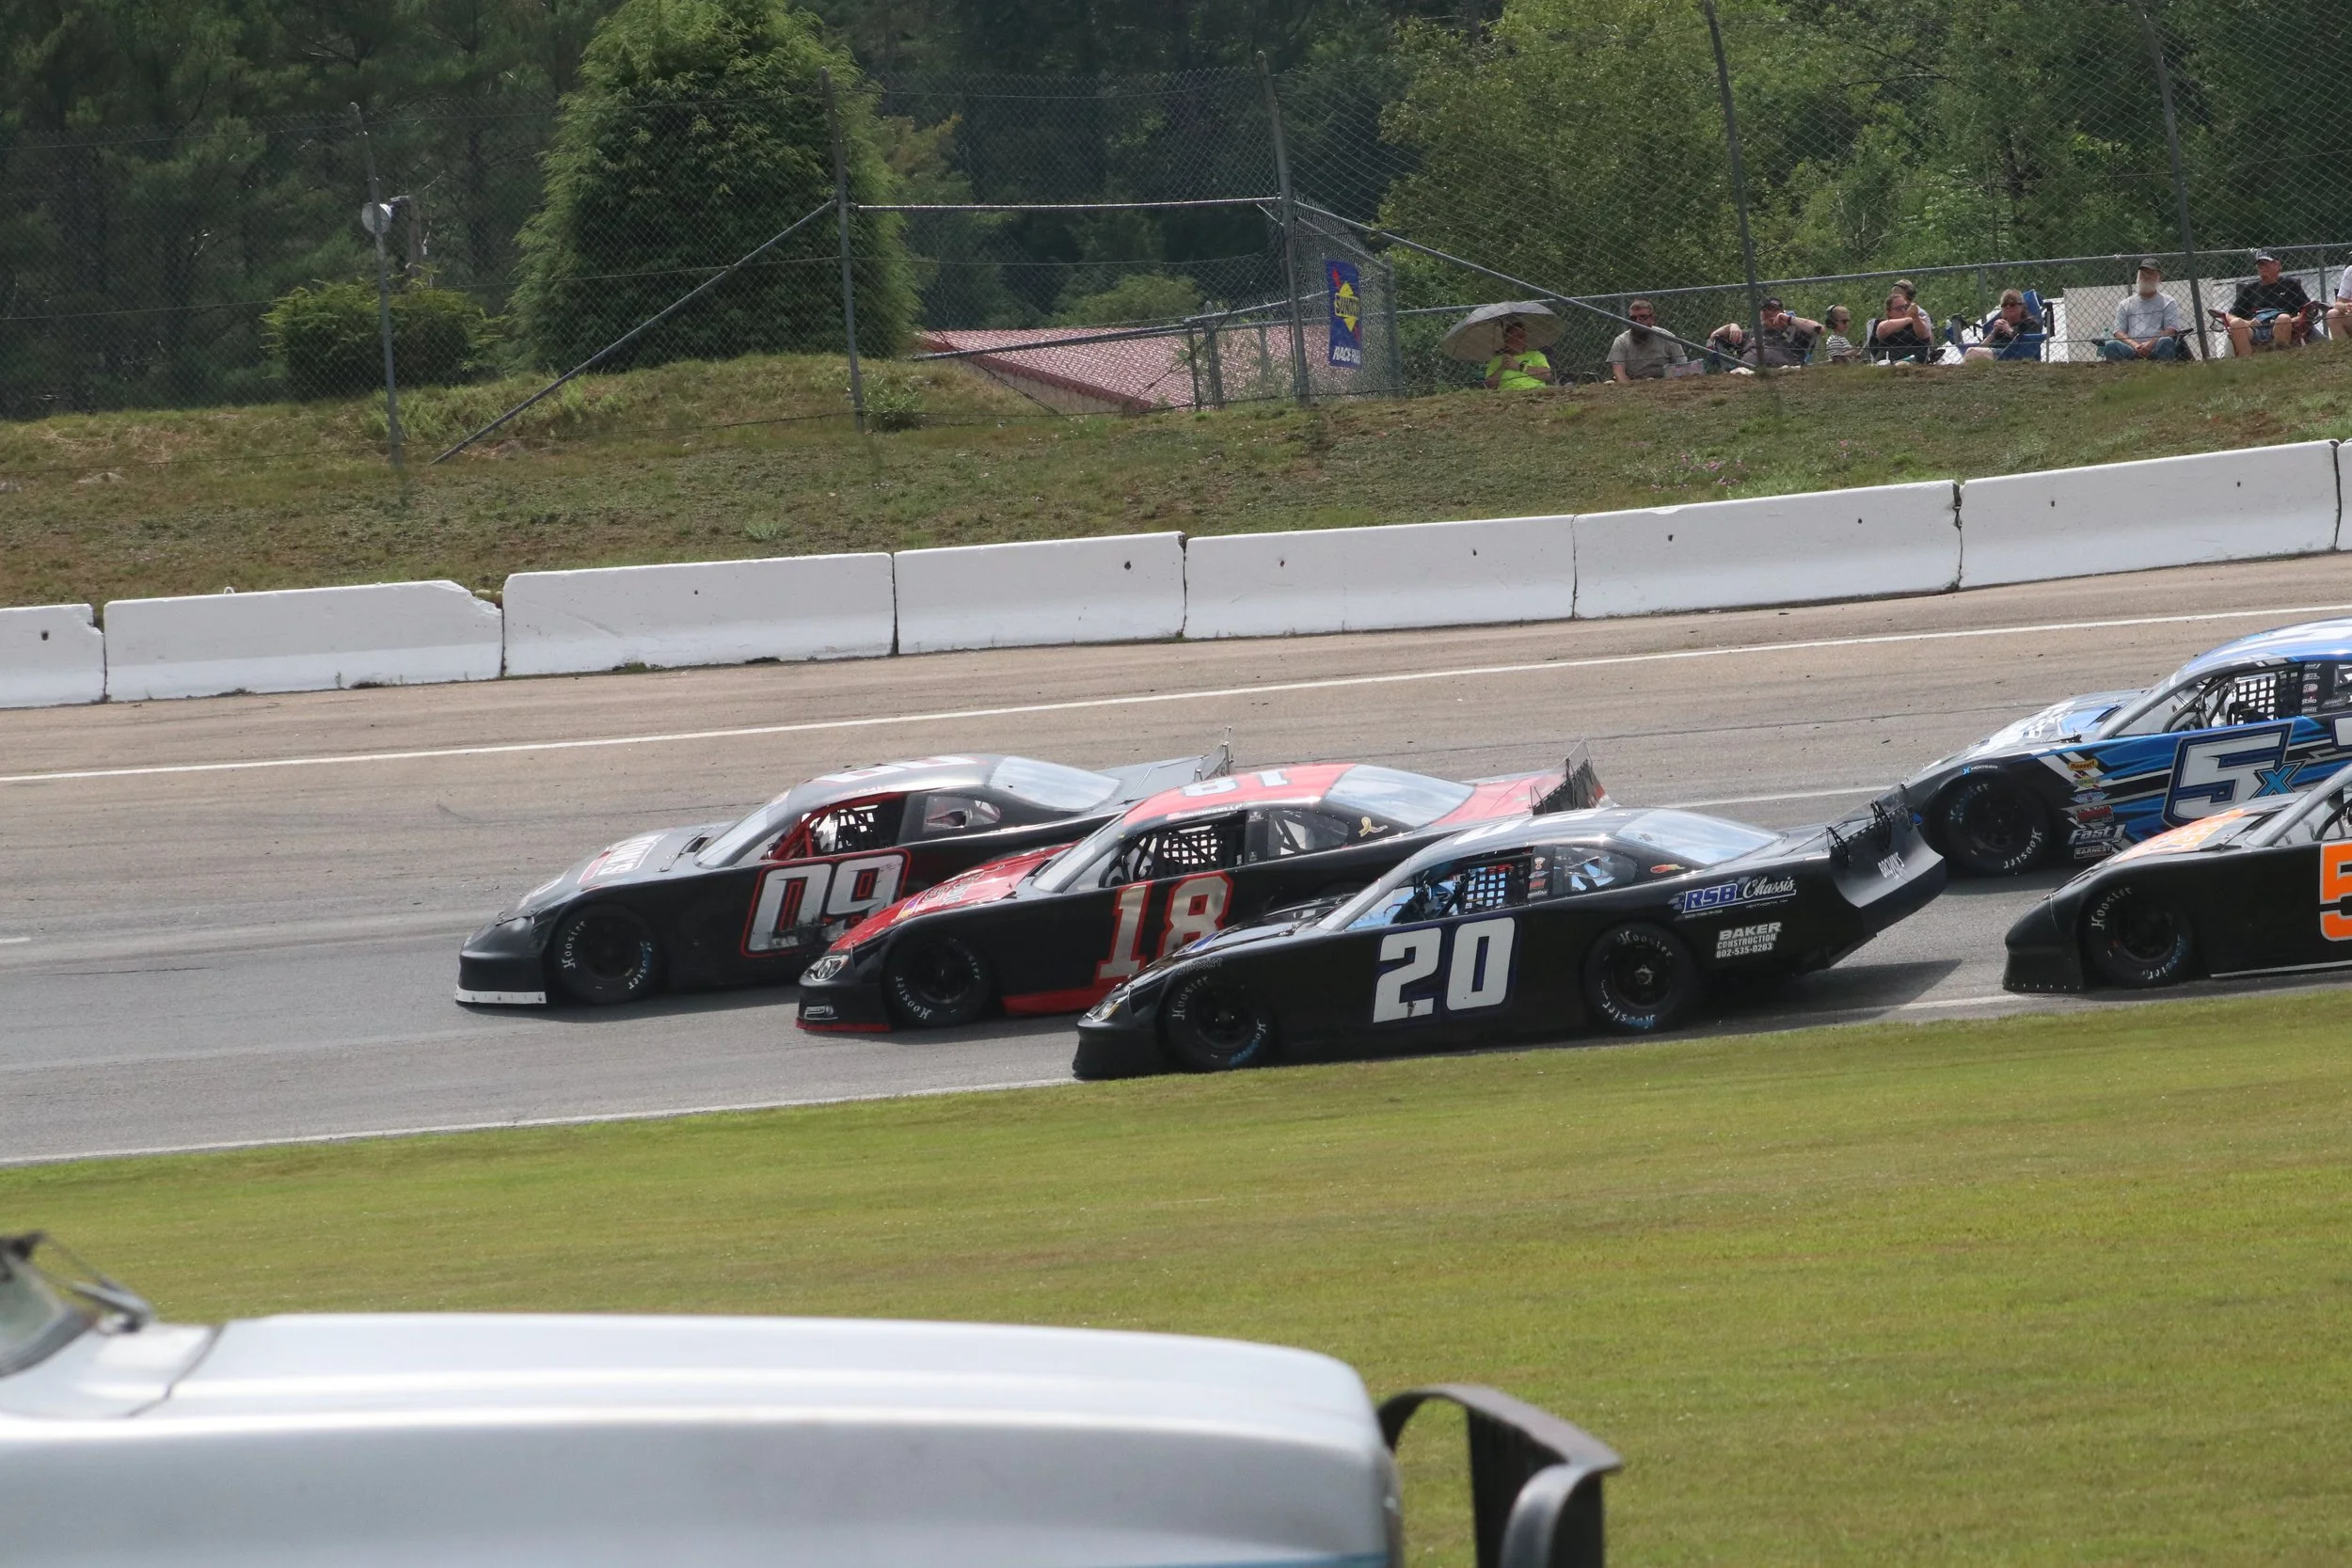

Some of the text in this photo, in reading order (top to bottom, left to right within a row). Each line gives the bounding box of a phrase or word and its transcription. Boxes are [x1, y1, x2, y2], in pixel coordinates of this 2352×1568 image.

[2003, 827, 2042, 870] Hoosier
[2069, 827, 2112, 845] Fast
[748, 854, 904, 952] 09
[1682, 876, 1795, 912] RSB Chassis
[2090, 887, 2132, 931] Hoosier
[562, 921, 586, 969] Hoosier
[1097, 877, 1230, 980] 18
[1716, 933, 1777, 950] CONSTRUCTION
[1718, 922, 1782, 942] BAKER
[1373, 917, 1516, 1023] 20
[896, 975, 934, 1021] Hoosier
[1172, 975, 1209, 1022] Hoosier
